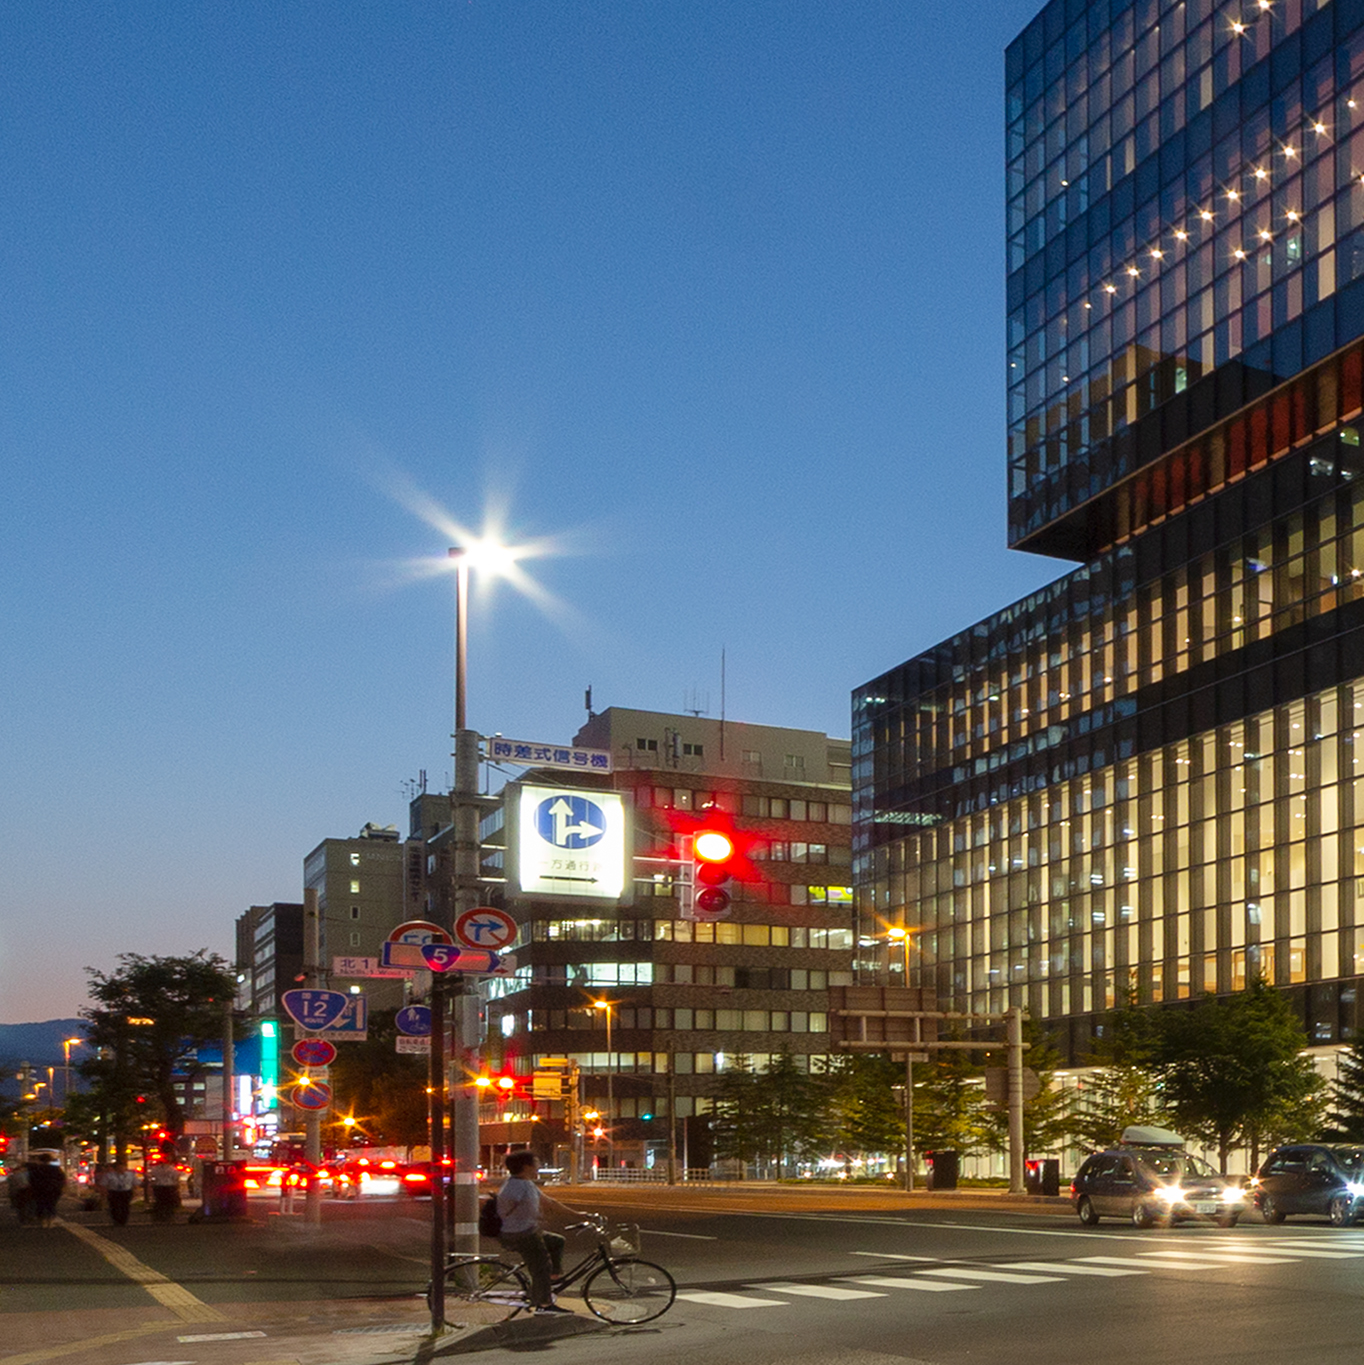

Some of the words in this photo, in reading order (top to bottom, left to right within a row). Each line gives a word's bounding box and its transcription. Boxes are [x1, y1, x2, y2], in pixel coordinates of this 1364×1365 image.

[494, 742, 608, 769] 時差式信号機
[433, 948, 449, 964] 5
[303, 1001, 328, 1017] 12
